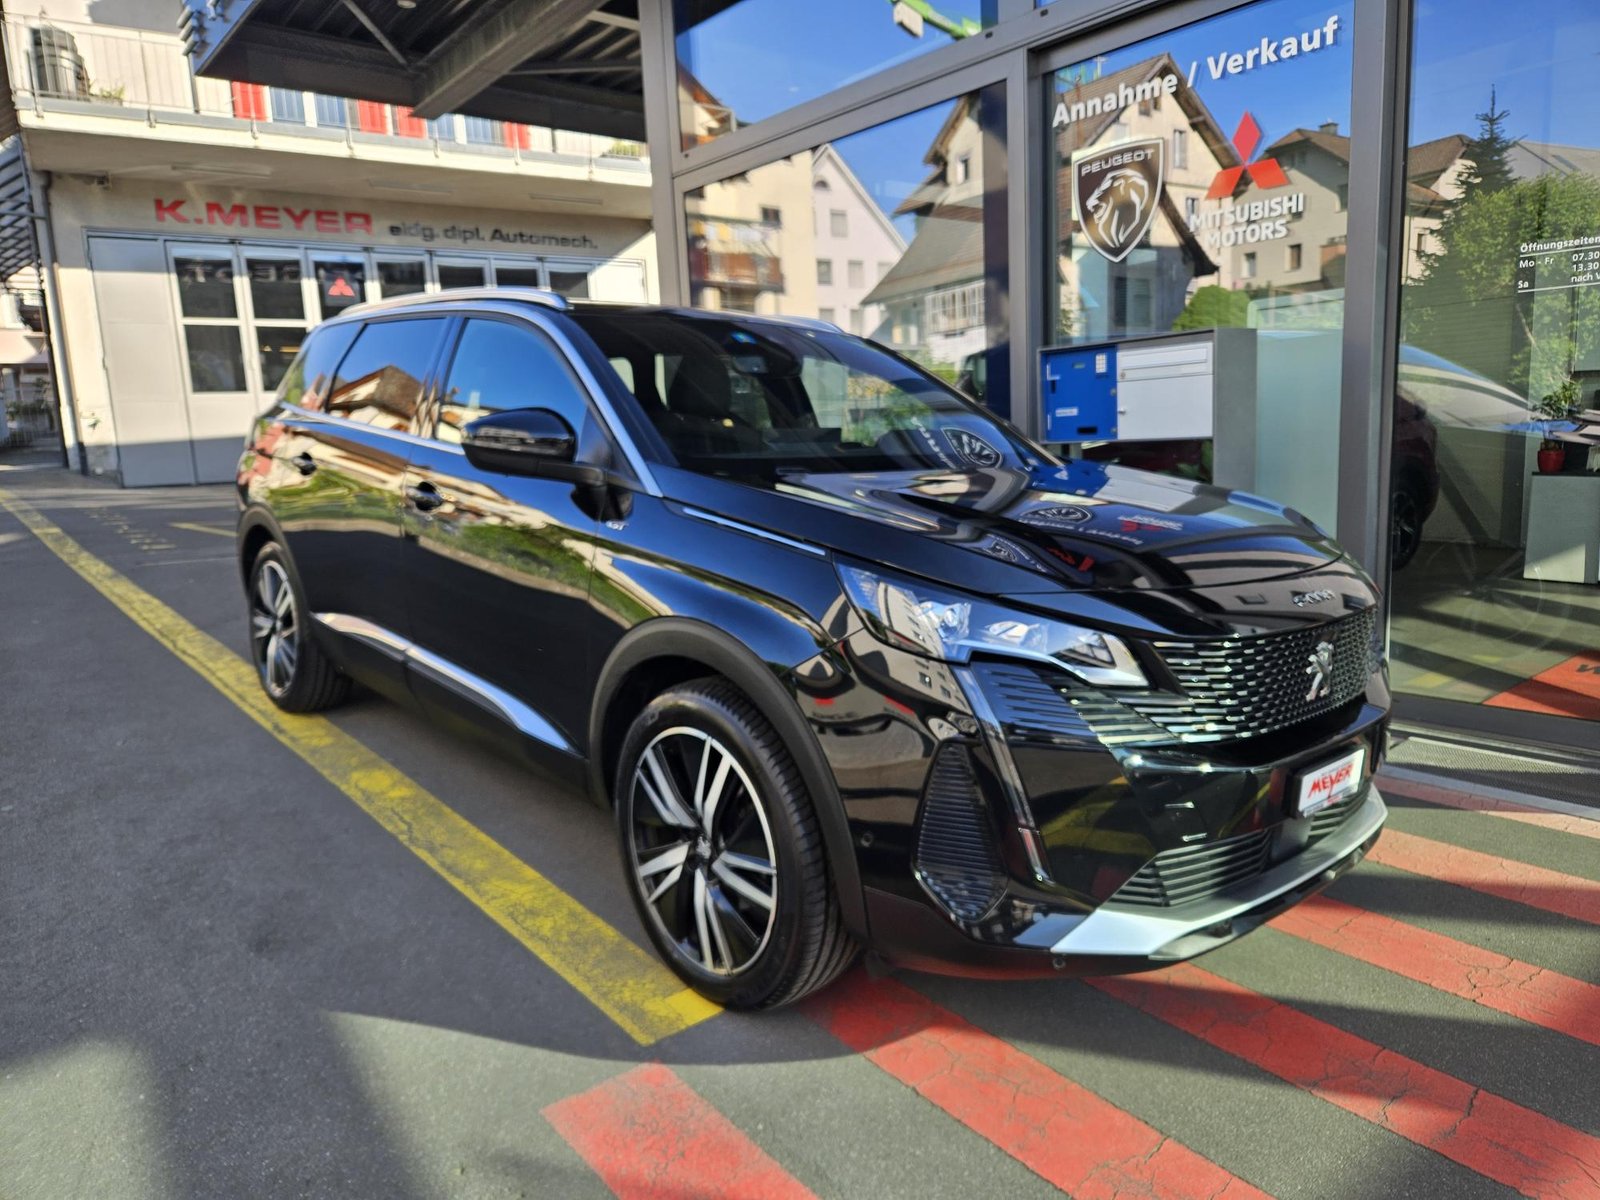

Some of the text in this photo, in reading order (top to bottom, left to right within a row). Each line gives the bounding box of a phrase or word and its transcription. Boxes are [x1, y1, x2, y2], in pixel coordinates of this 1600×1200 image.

[1053, 15, 1338, 127] Annahme / Verkauf
[1081, 149, 1153, 176] PEUGEOT
[154, 198, 373, 235] K.MEYER
[1189, 192, 1304, 232] MITSUBISHI
[443, 225, 485, 244] dipl.
[489, 228, 599, 249] Automech.
[1205, 219, 1288, 247] MOTORS
[1520, 236, 1600, 252] Öffnungszeiten
[1519, 259, 1535, 268] Mo
[1572, 251, 1600, 261] 07.30
[1572, 261, 1600, 272] 13.30
[1517, 280, 1529, 289] Sa
[1571, 272, 1593, 283] nach
[1307, 763, 1353, 799] MEYER
